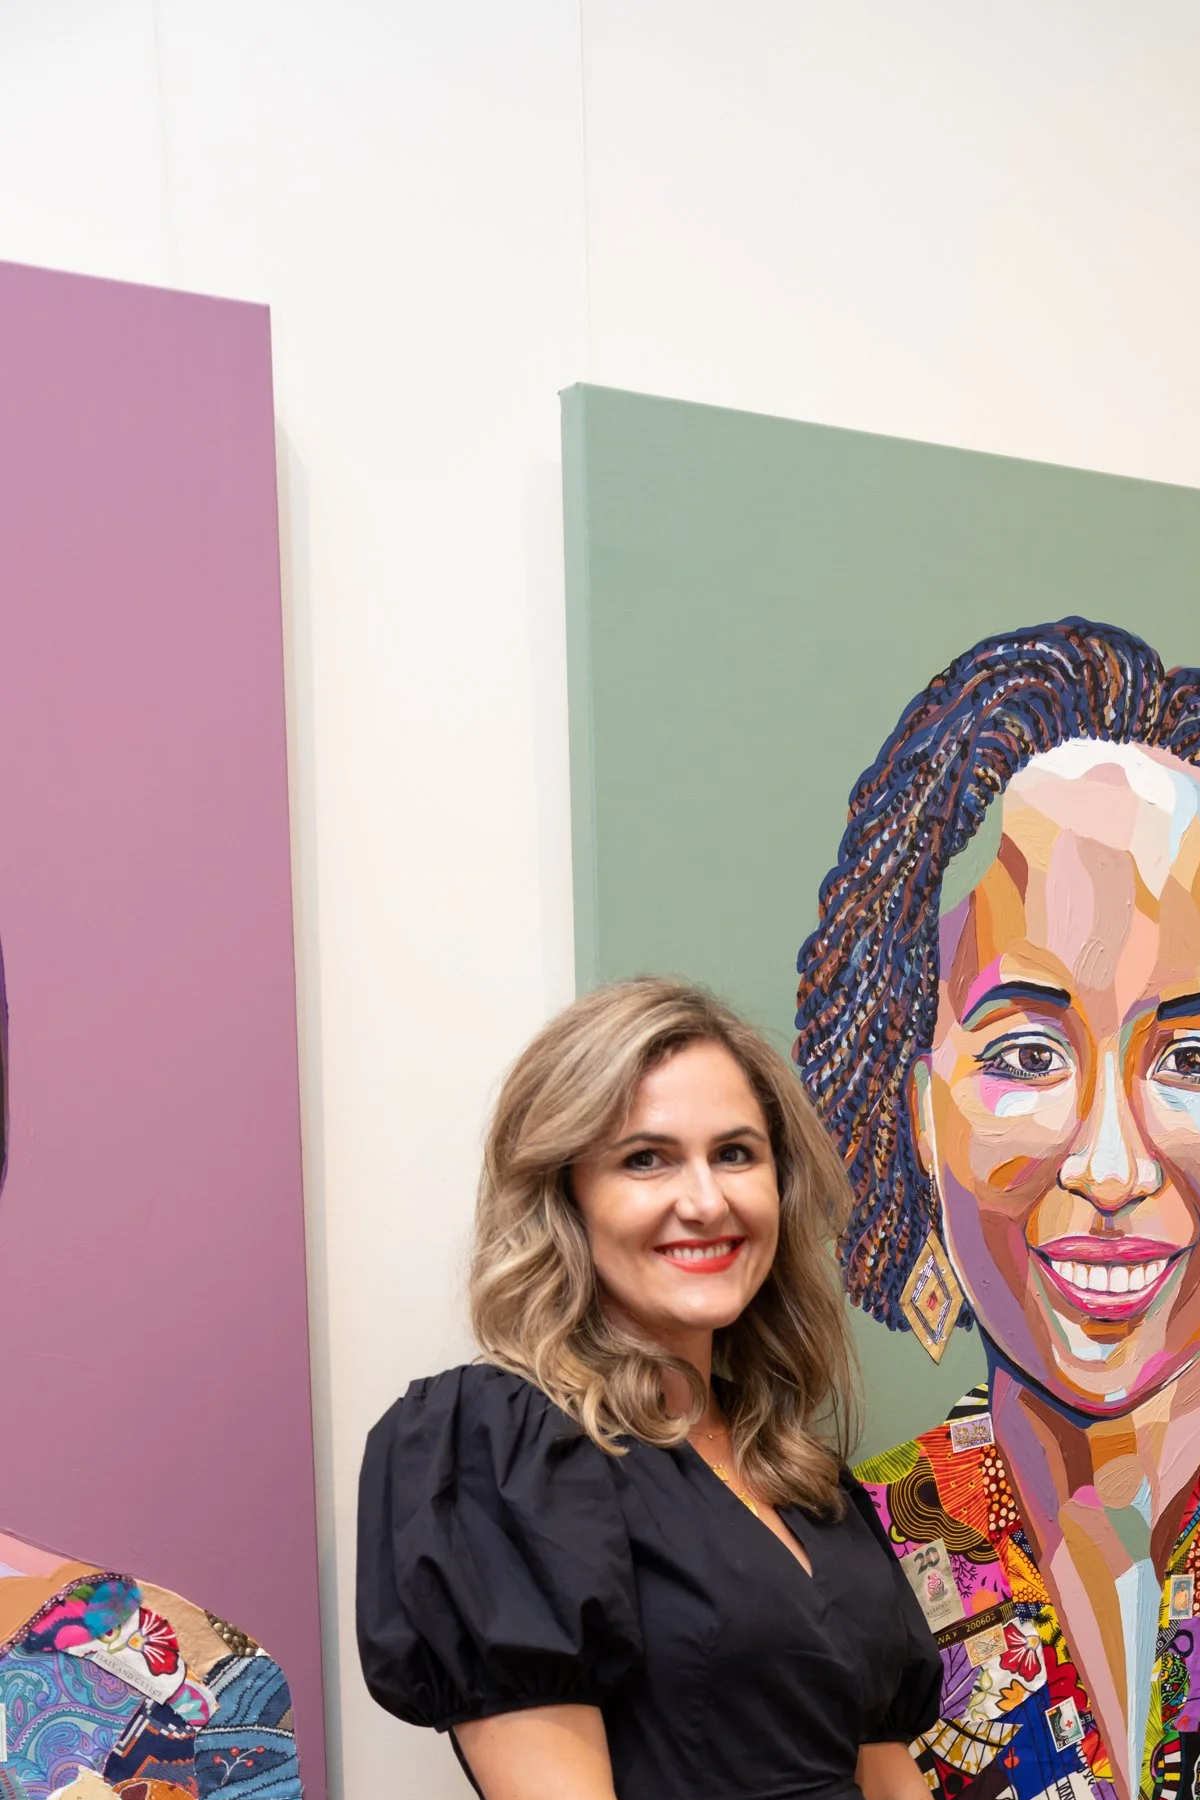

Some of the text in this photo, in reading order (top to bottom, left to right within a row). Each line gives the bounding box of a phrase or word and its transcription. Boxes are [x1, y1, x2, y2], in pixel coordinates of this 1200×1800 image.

[914, 1547, 940, 1575] 20
[96, 1653, 117, 1668] ITALY
[116, 1667, 134, 1680] AND
